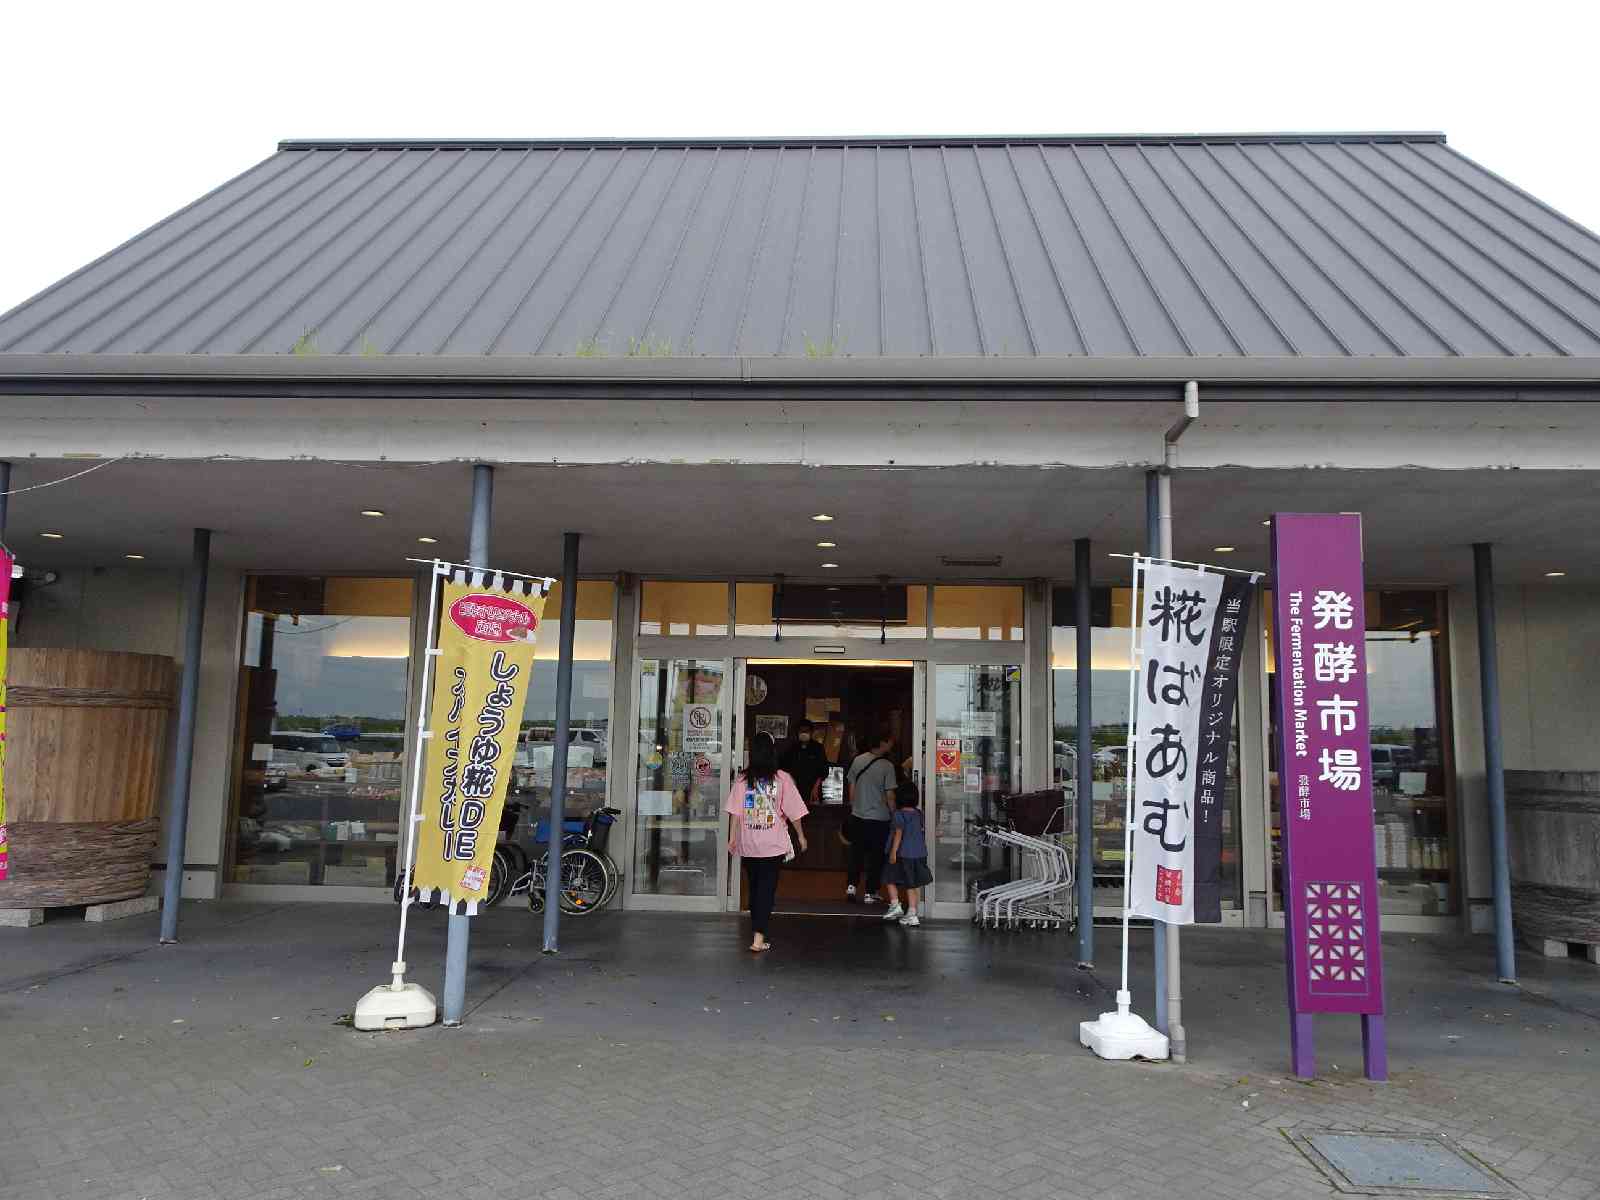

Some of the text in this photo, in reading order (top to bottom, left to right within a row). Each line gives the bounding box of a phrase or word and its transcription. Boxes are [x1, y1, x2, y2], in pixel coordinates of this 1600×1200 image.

[1143, 585, 1206, 852] 糀ばあむ
[1289, 591, 1310, 758] The Fermentation Market
[1312, 590, 1362, 791] 発酵市場
